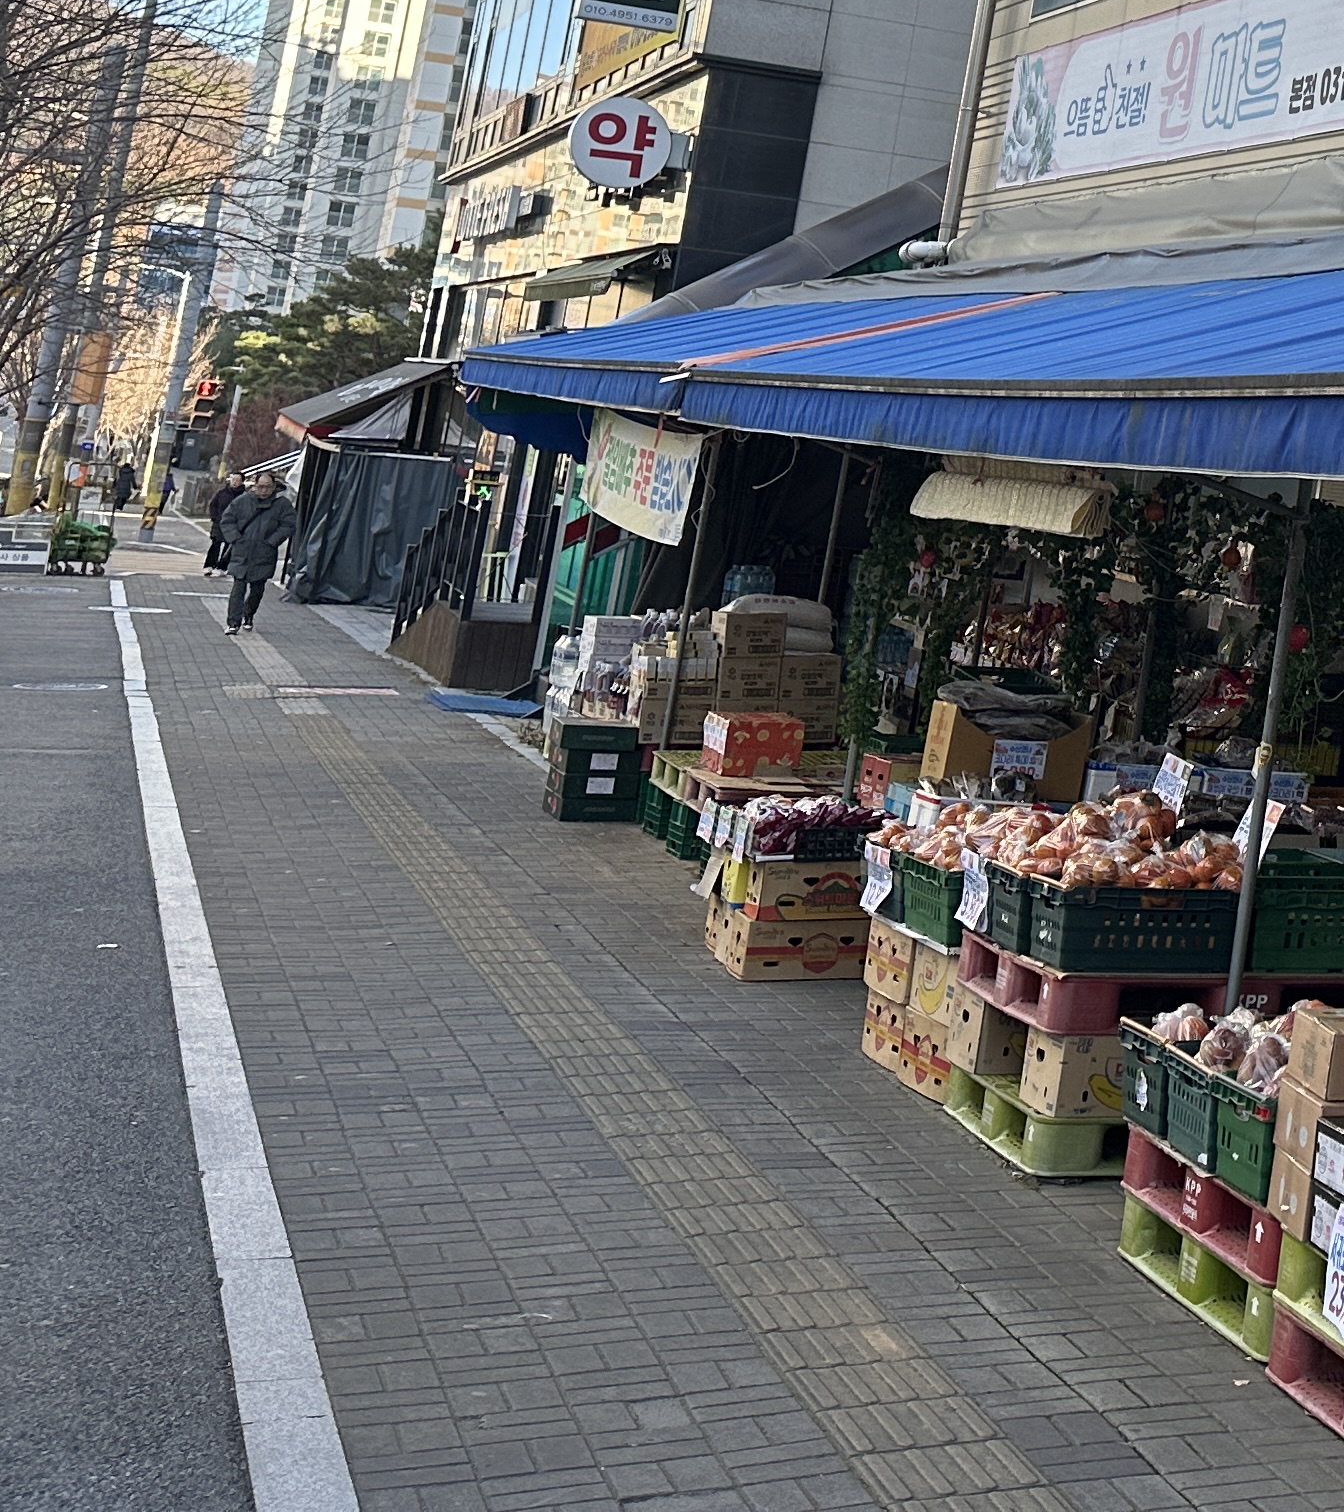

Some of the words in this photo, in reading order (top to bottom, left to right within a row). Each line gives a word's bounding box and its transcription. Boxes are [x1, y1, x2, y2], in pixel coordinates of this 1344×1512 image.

[1063, 100, 1091, 140] 으뜸
[1114, 81, 1151, 129] 친절!
[1289, 73, 1318, 116] 본점
[588, 112, 657, 179] 약
[634, 449, 655, 505] 주문
[1184, 1176, 1202, 1198] KPP
